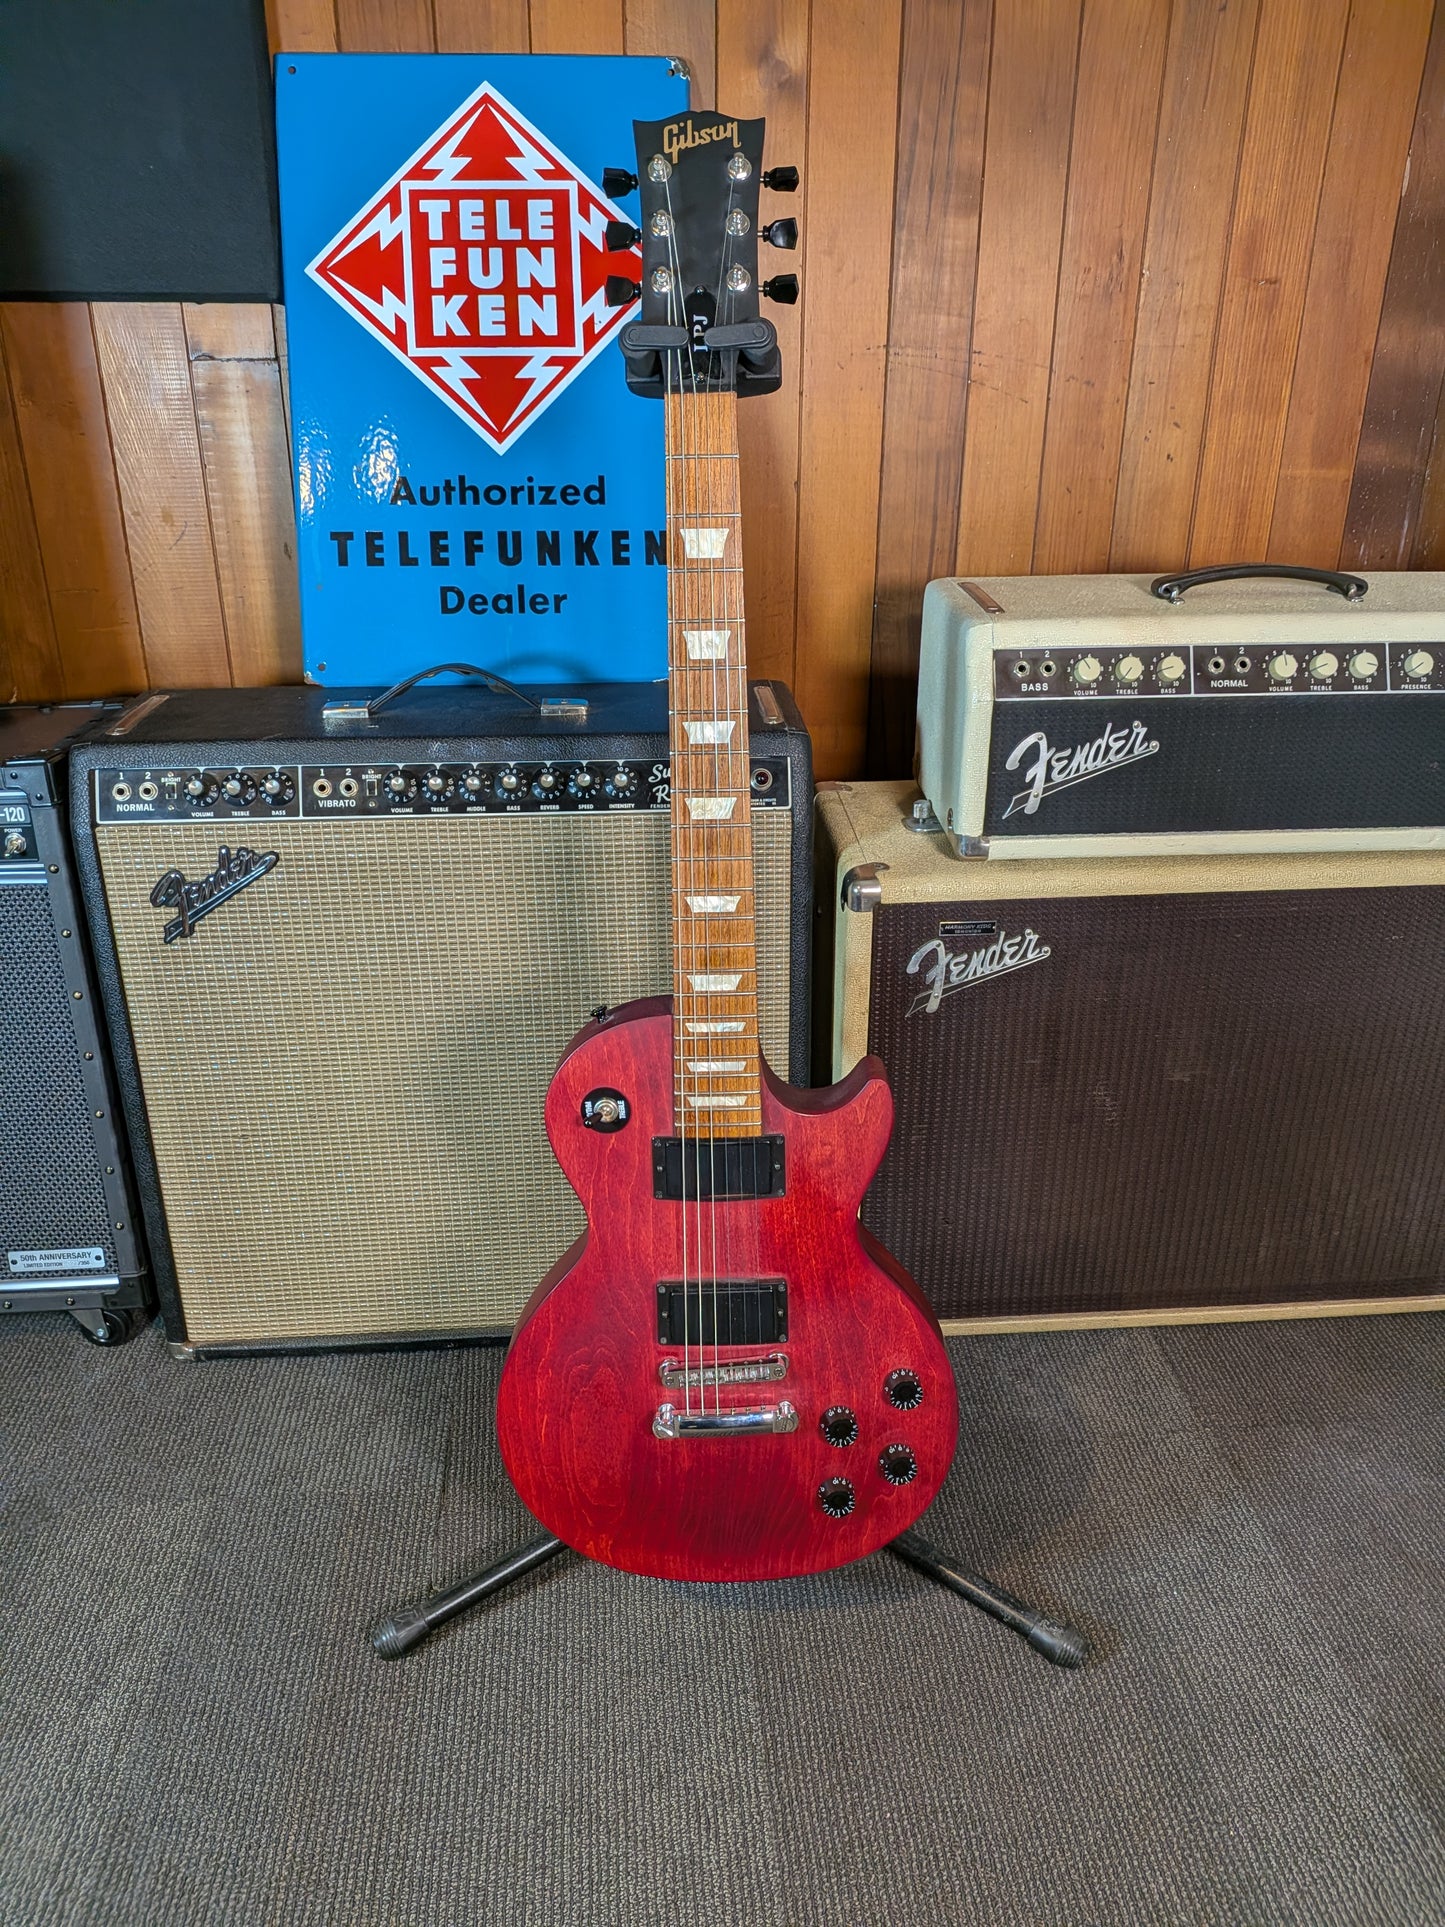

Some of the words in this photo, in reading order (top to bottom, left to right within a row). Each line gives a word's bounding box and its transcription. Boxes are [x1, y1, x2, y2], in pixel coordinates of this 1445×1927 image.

[663, 119, 742, 164] Gibson
[418, 199, 555, 242] TELE
[430, 247, 557, 289] FUN
[431, 294, 559, 338] KEN
[389, 474, 606, 508] Authorized
[329, 530, 667, 567] TELEFUNKEN
[440, 585, 568, 615] Dealer
[1019, 651, 1023, 659] 1
[1044, 650, 1050, 658] 2
[1021, 683, 1049, 692] BASS
[1210, 680, 1249, 688] NORMAL
[119, 772, 124, 780] 1
[320, 768, 325, 776] 1
[345, 768, 351, 776] 2
[1003, 721, 1160, 819] Fender
[0, 806, 26, 822] -120
[116, 803, 155, 812] NORMAL
[318, 799, 356, 808] VIBRATO
[150, 844, 279, 944] Fender
[905, 928, 1051, 1017] Fender
[20, 1254, 37, 1262] 50th
[39, 1251, 92, 1261] ANNIVERSARY
